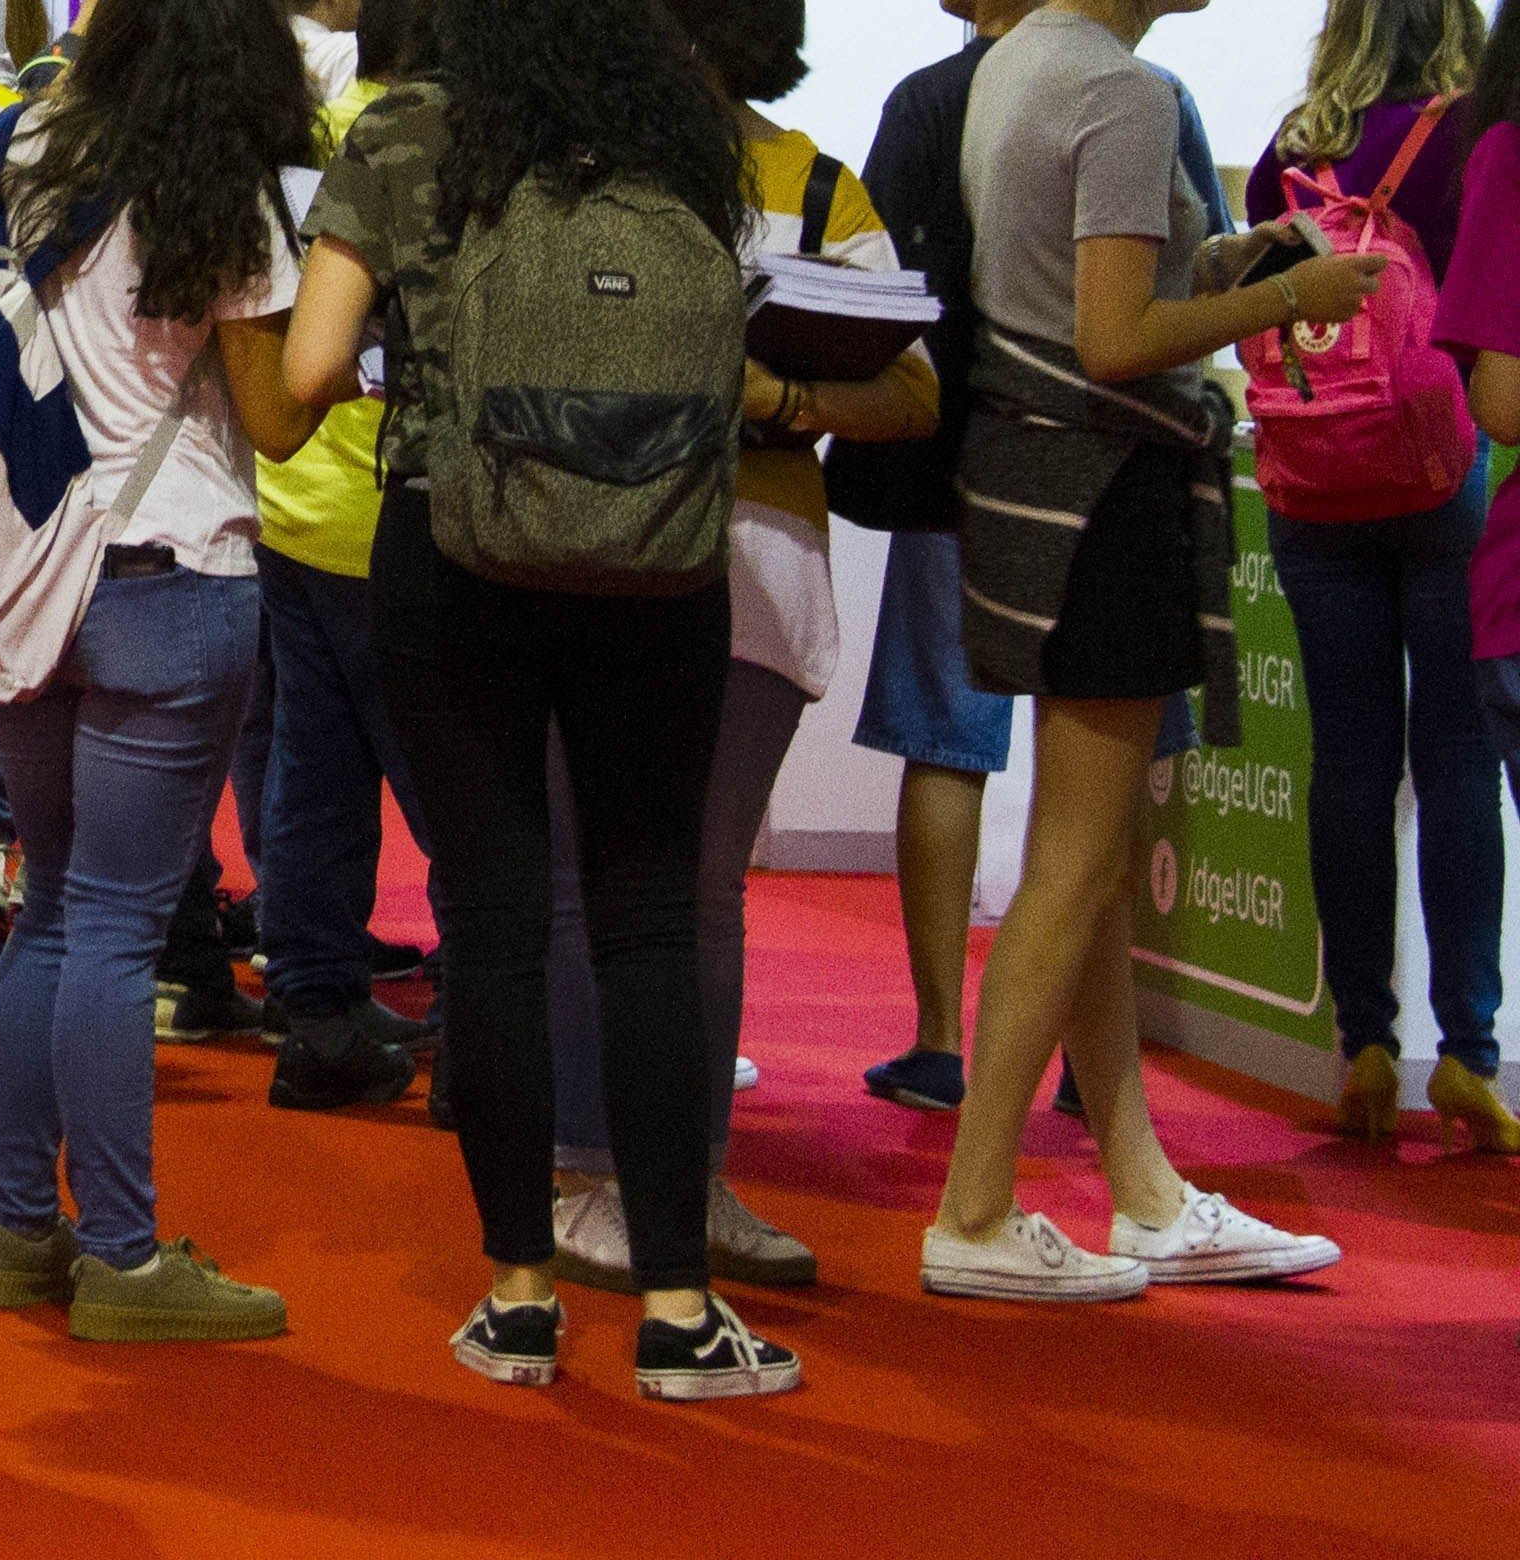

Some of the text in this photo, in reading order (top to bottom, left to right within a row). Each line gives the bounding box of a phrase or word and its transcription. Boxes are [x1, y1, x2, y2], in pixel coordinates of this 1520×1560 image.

[593, 275, 630, 292] VANS
[1182, 748, 1294, 822] @dgeUGR
[1184, 855, 1284, 931] /dgeUGR
